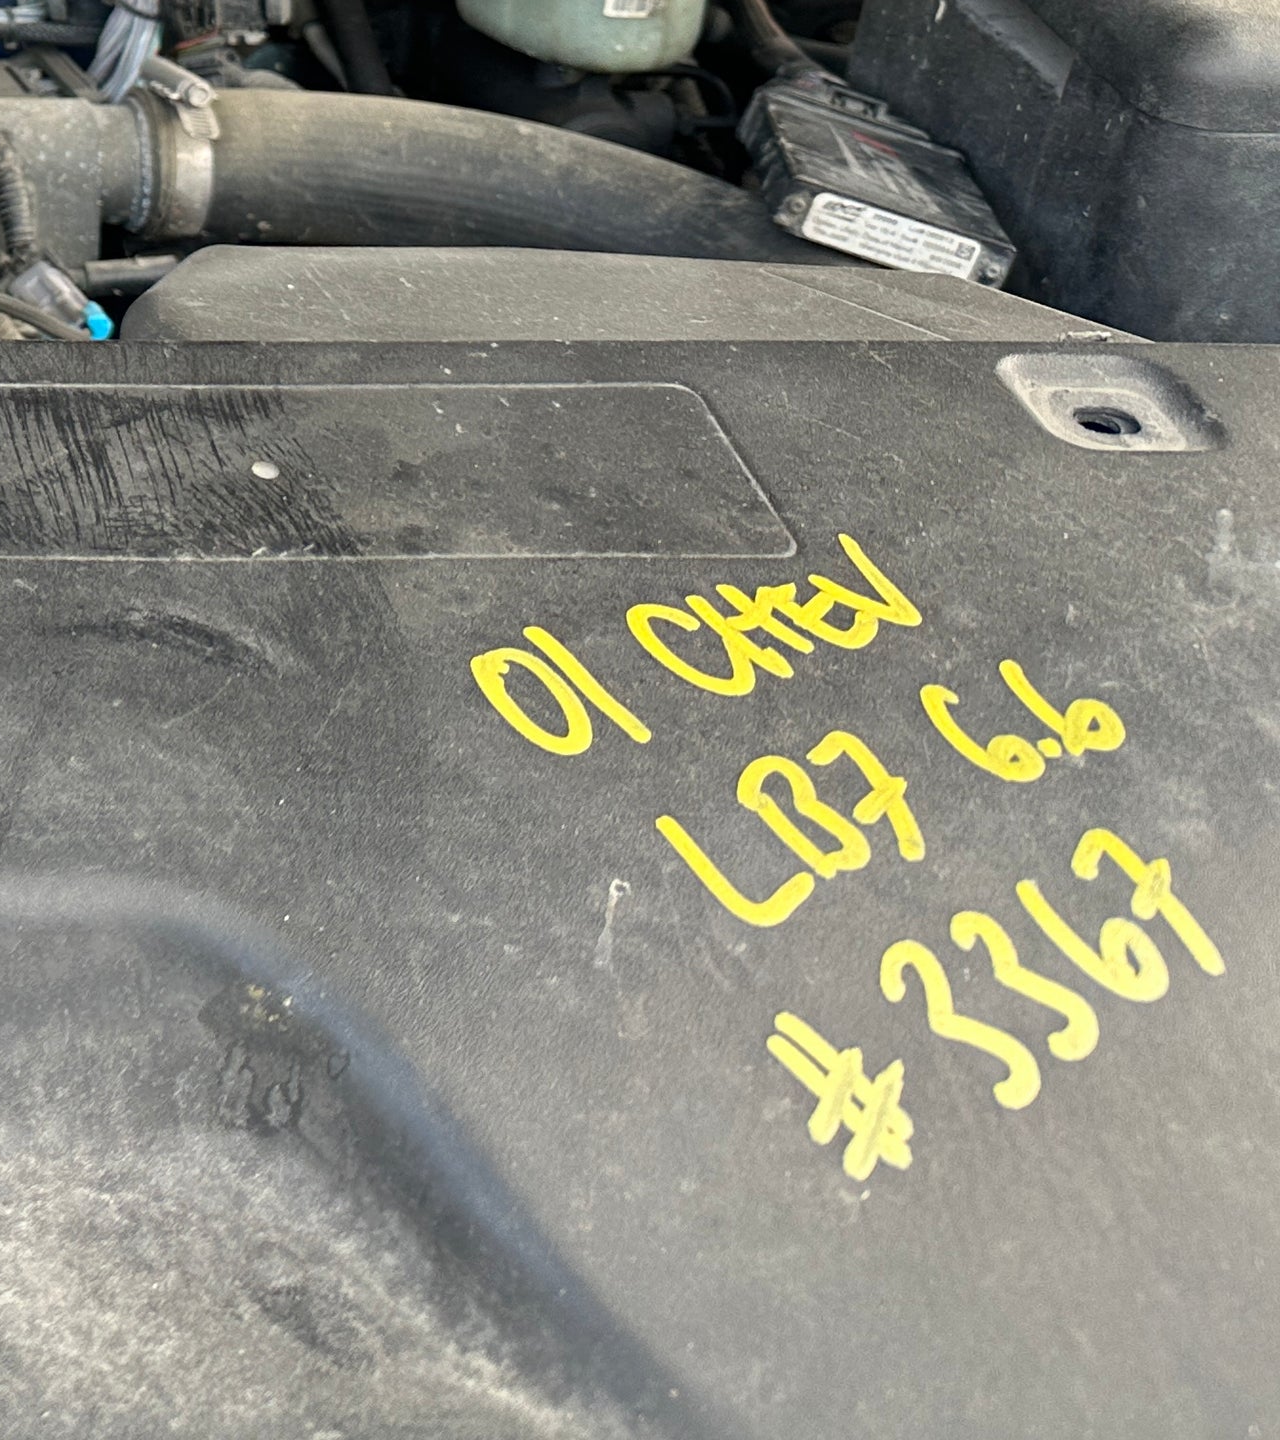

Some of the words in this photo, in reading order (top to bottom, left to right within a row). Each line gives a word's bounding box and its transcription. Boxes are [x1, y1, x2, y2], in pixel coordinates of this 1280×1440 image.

[470, 624, 652, 757] 01
[655, 728, 926, 927] LB7
[920, 658, 1127, 784] 6.6
